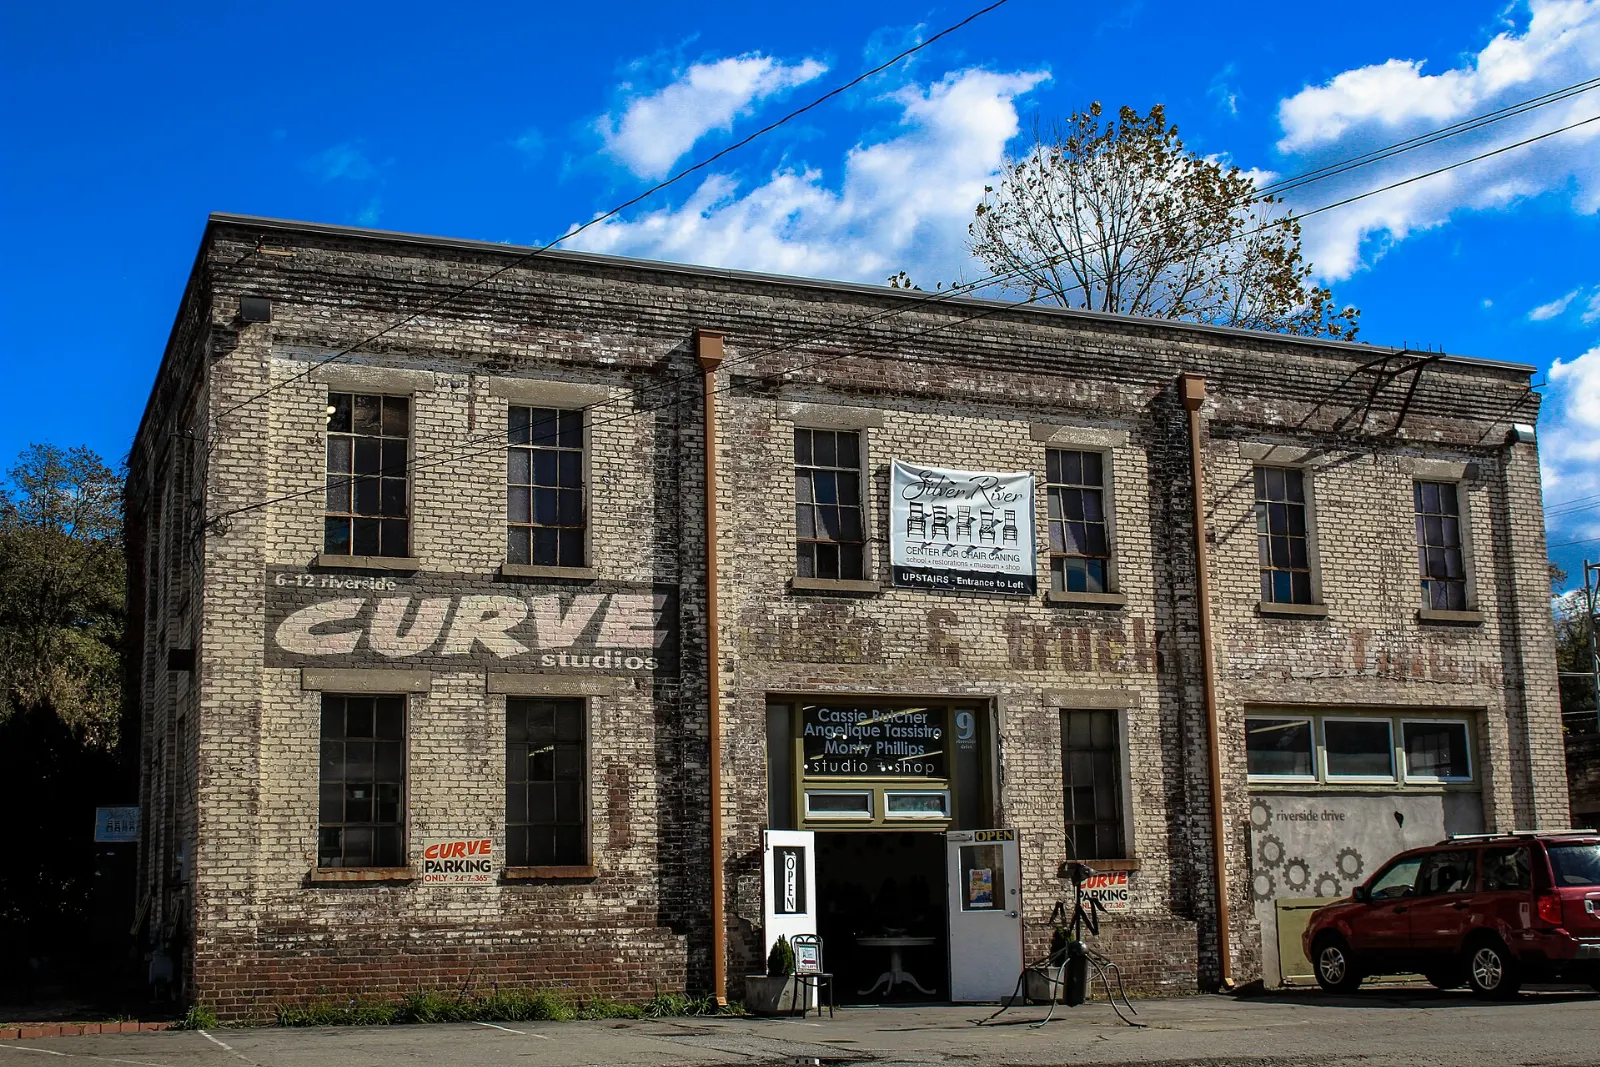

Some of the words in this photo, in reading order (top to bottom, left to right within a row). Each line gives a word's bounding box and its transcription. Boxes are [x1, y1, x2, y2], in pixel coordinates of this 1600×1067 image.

[902, 470, 965, 501] Silver
[968, 475, 1023, 509] River
[905, 546, 940, 557] CENTER
[942, 549, 959, 558] FOR
[961, 550, 987, 560] CHAIR
[988, 552, 1020, 562] CANING
[905, 556, 927, 564] school
[932, 559, 968, 567] restorations
[275, 574, 315, 587] 6-12
[321, 575, 396, 590] riverside
[902, 573, 949, 584] UPSTAIRS
[957, 577, 994, 587] Entrance
[1007, 581, 1024, 589] Left
[274, 594, 669, 658] CURVE
[541, 649, 659, 671] studios
[818, 708, 867, 723] Cassie
[872, 709, 928, 724] Butcher
[804, 723, 880, 739] Angelique
[884, 724, 942, 739] Tassistro
[956, 711, 975, 740] 9
[824, 741, 871, 757] Monty
[876, 741, 925, 756] Phillips
[813, 760, 868, 772] studio
[895, 760, 935, 775] shop
[1276, 809, 1318, 821] riverside
[1321, 809, 1345, 821] drive
[975, 831, 1012, 841] OPEN
[425, 840, 491, 859] CURVE
[425, 860, 491, 873] PARKING
[786, 857, 795, 909] OPEN
[1080, 871, 1127, 888] URVE
